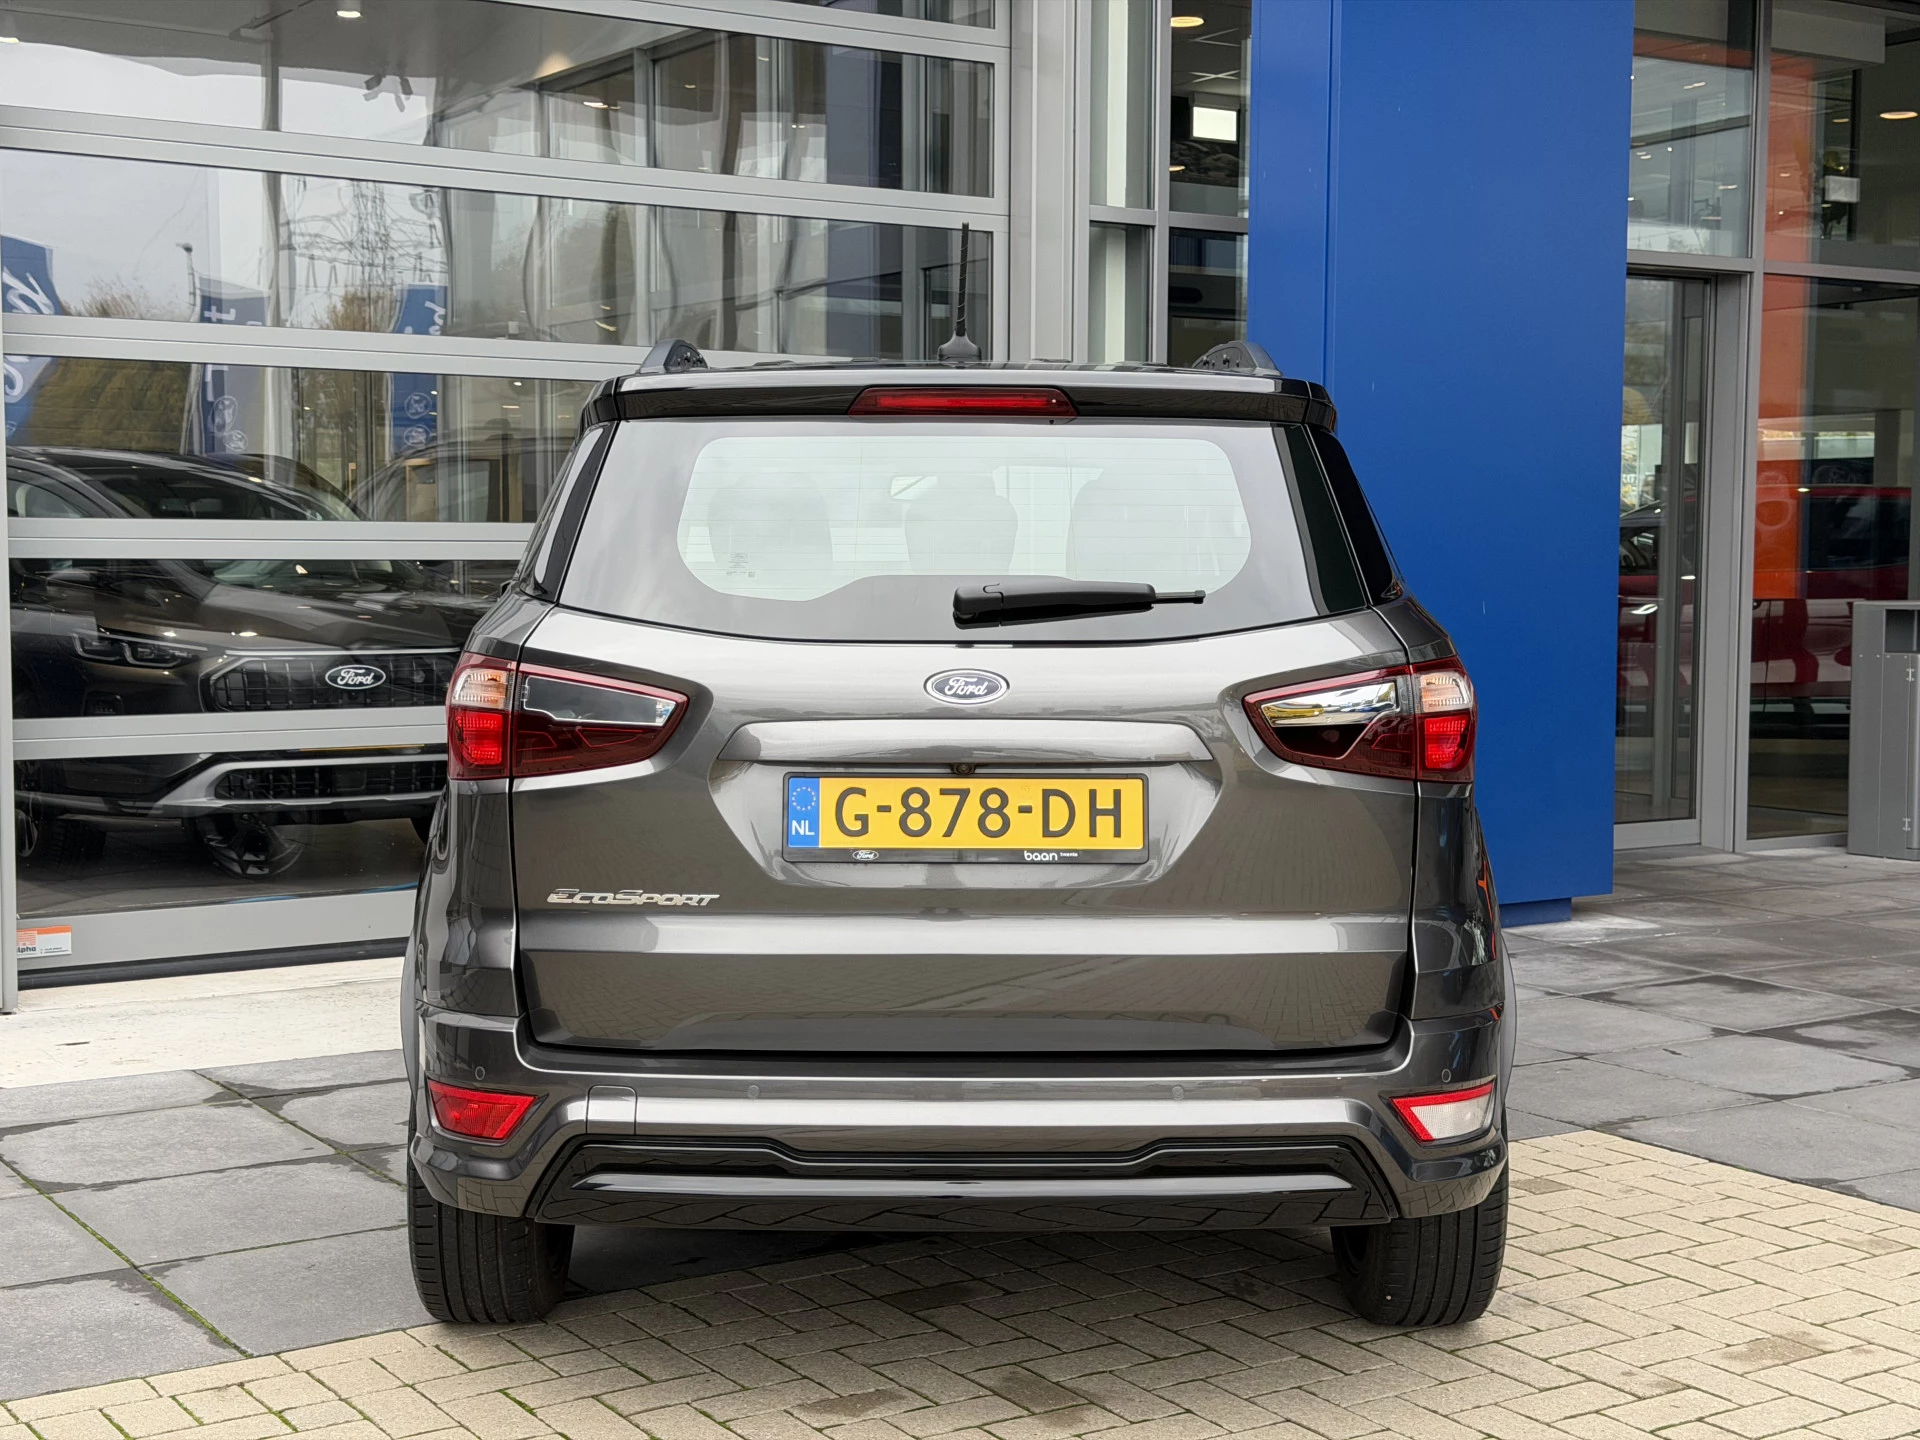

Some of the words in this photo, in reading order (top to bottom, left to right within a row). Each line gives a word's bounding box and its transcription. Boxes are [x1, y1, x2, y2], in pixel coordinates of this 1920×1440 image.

[337, 668, 375, 685] Ford
[944, 677, 989, 695] Ford
[835, 786, 1122, 838] G-878-DH
[791, 819, 816, 836] NL
[1024, 850, 1058, 861] baan
